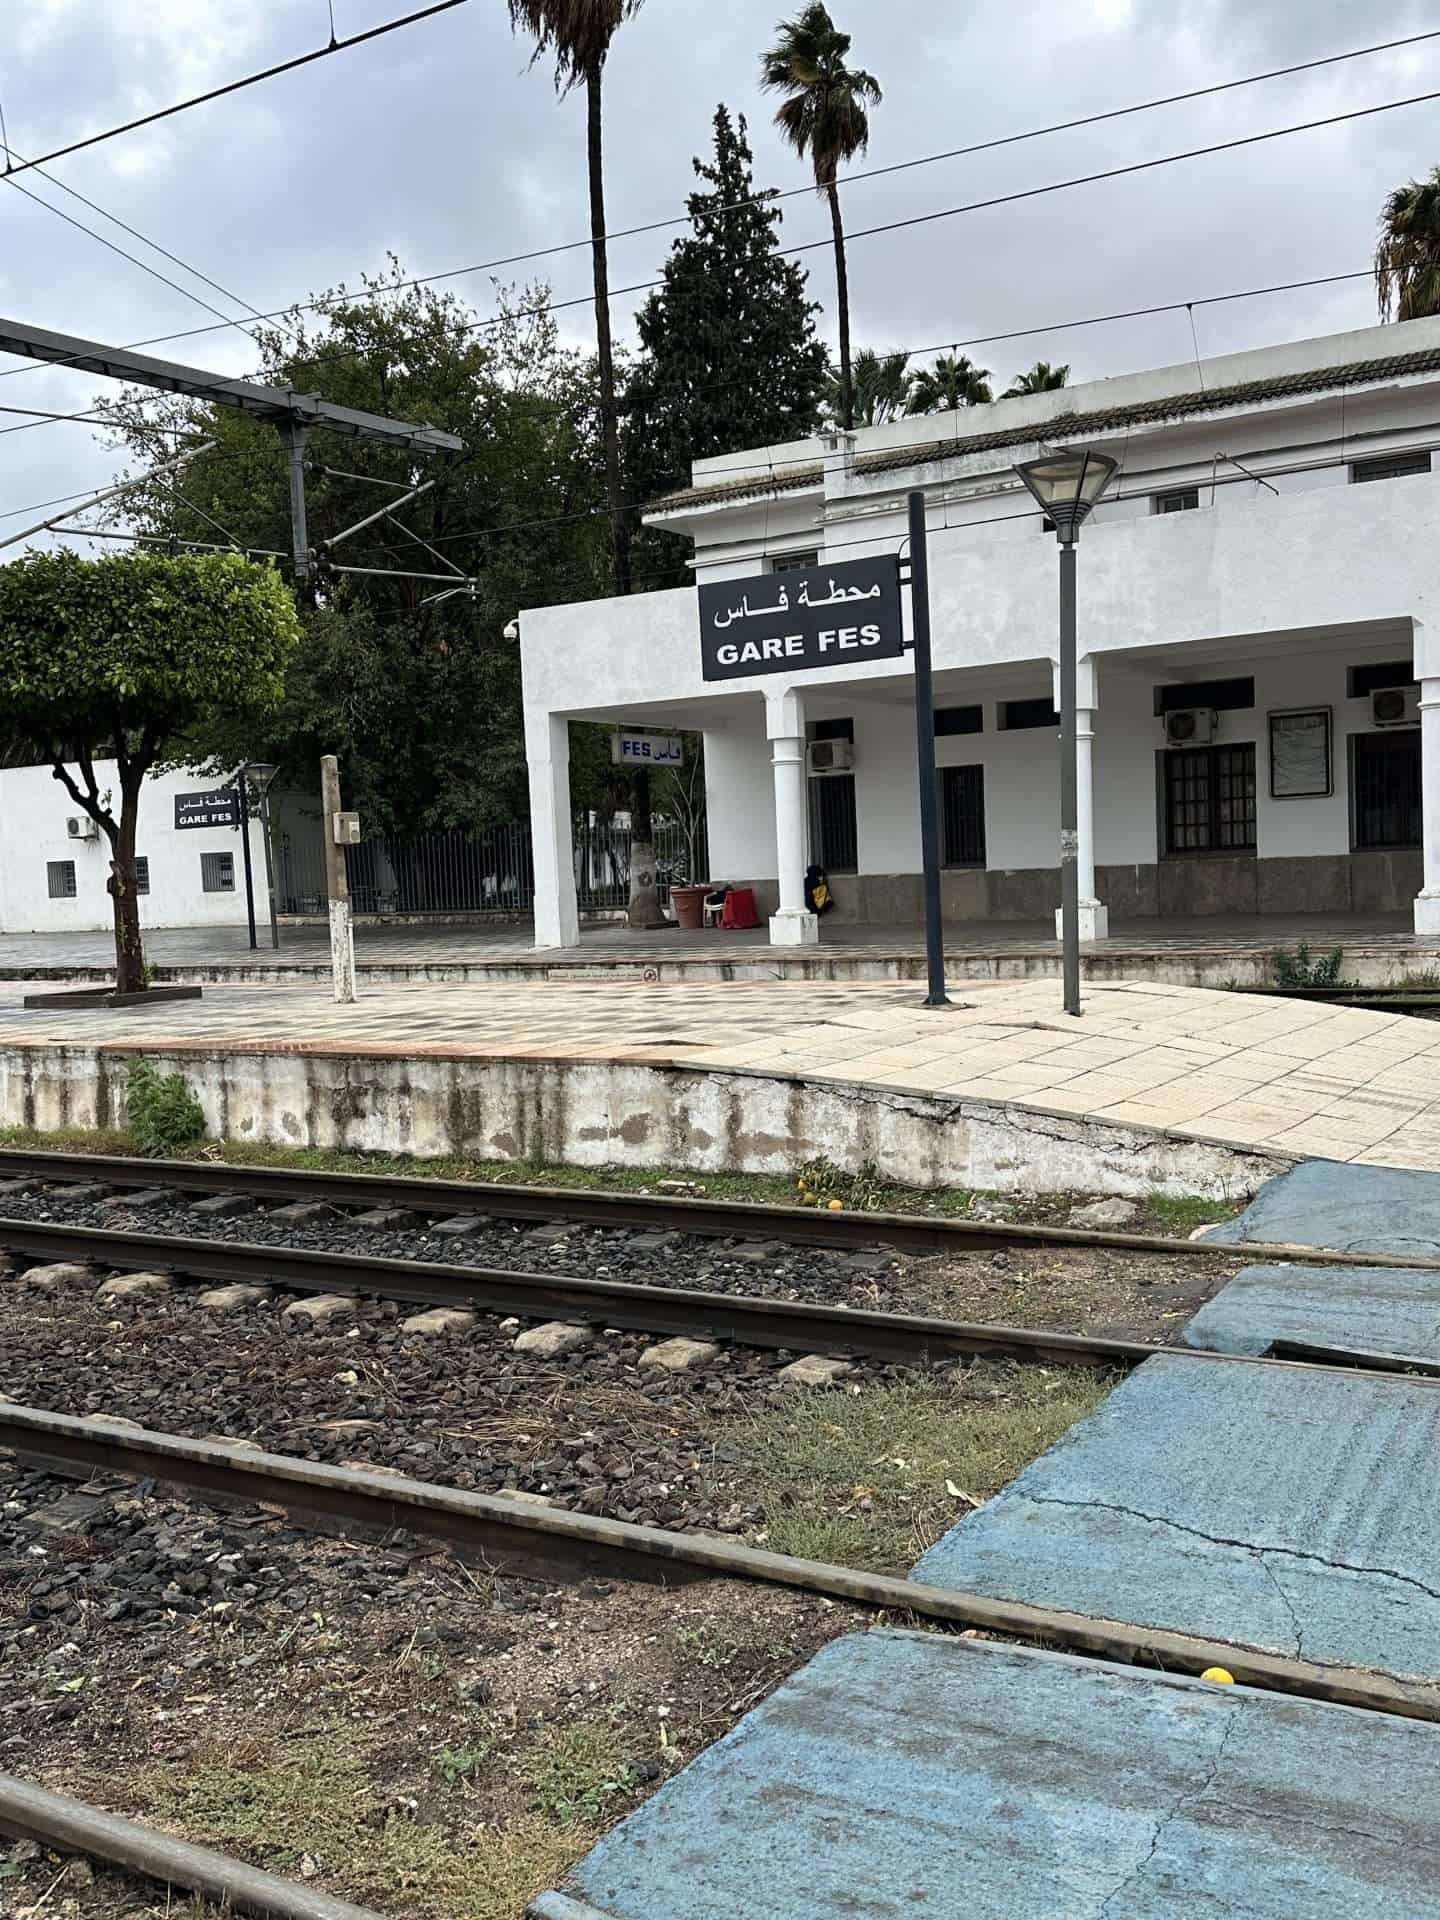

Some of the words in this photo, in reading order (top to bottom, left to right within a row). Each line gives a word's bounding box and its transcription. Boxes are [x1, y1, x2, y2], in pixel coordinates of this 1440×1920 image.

[713, 584, 789, 628] فاس
[797, 576, 881, 607] محطة
[716, 634, 805, 665] GARE
[818, 624, 881, 652] FES
[623, 741, 651, 757] FES
[179, 814, 208, 825] GARE
[211, 812, 232, 822] FES
